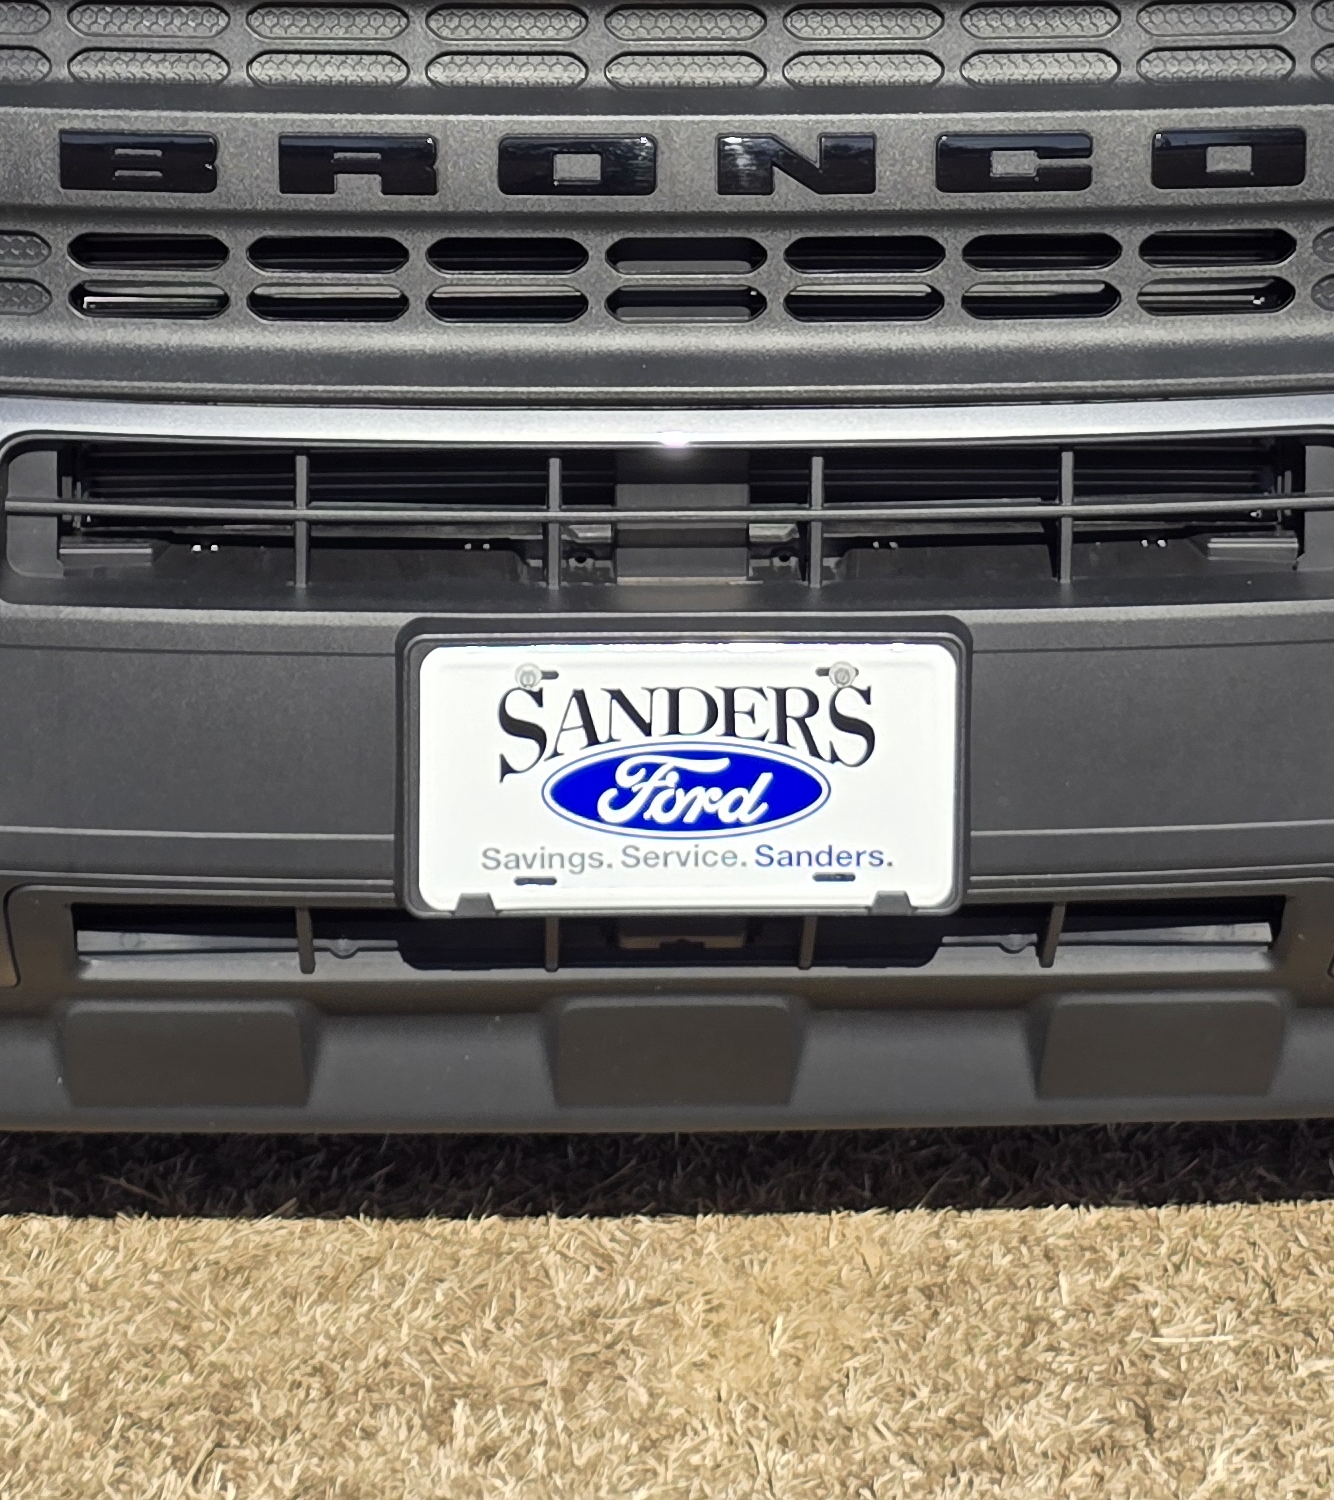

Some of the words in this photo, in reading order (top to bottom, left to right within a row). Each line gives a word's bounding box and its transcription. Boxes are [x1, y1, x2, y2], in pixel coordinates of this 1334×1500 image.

[58, 125, 1307, 196] BRONCO
[498, 684, 876, 782] SANDERS
[596, 754, 774, 826] Ford
[481, 847, 613, 875] Savings.
[620, 843, 748, 870] Service.
[755, 843, 895, 869] Sanders.
